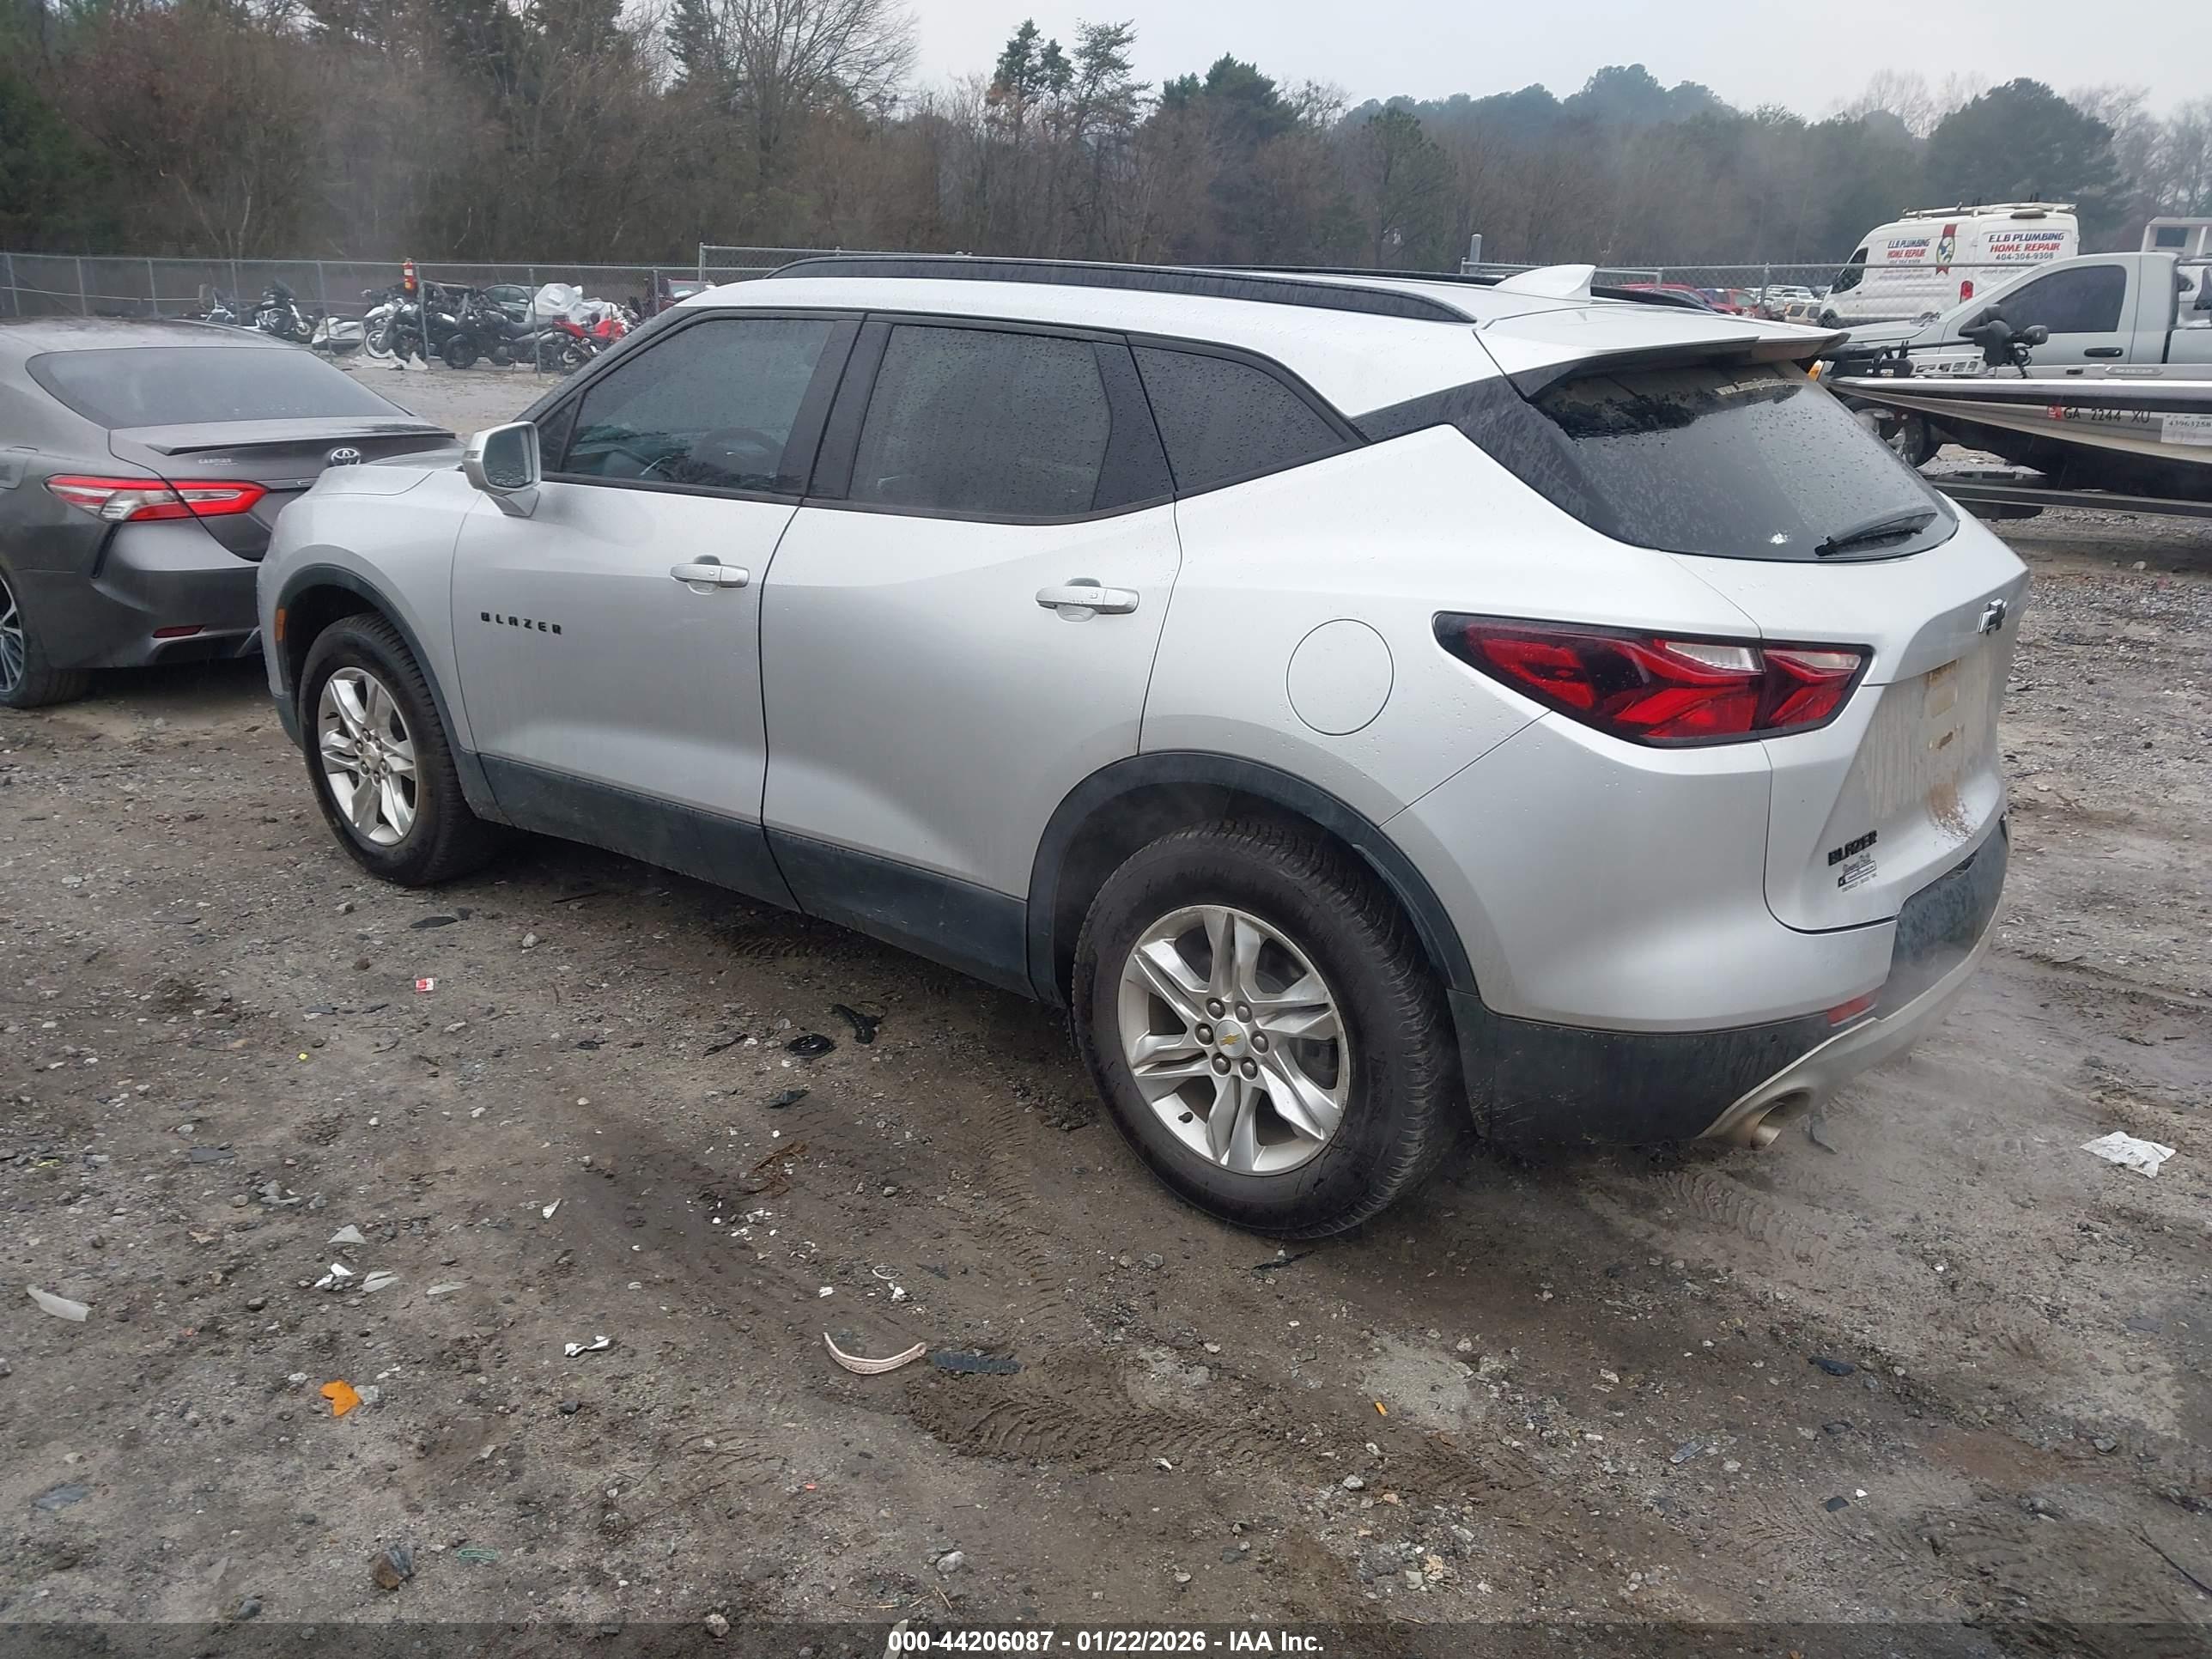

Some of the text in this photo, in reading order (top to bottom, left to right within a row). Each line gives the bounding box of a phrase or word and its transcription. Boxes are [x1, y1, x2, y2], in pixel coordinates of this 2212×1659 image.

[2012, 232, 2065, 242] PLUMBING
[1990, 242, 2062, 253] HOME REPAIR
[2063, 407, 2081, 420] GA
[2090, 407, 2122, 422] 2244
[2131, 410, 2151, 423] XU
[481, 611, 562, 635] BLAZER
[1827, 830, 1878, 866] BLAZER
